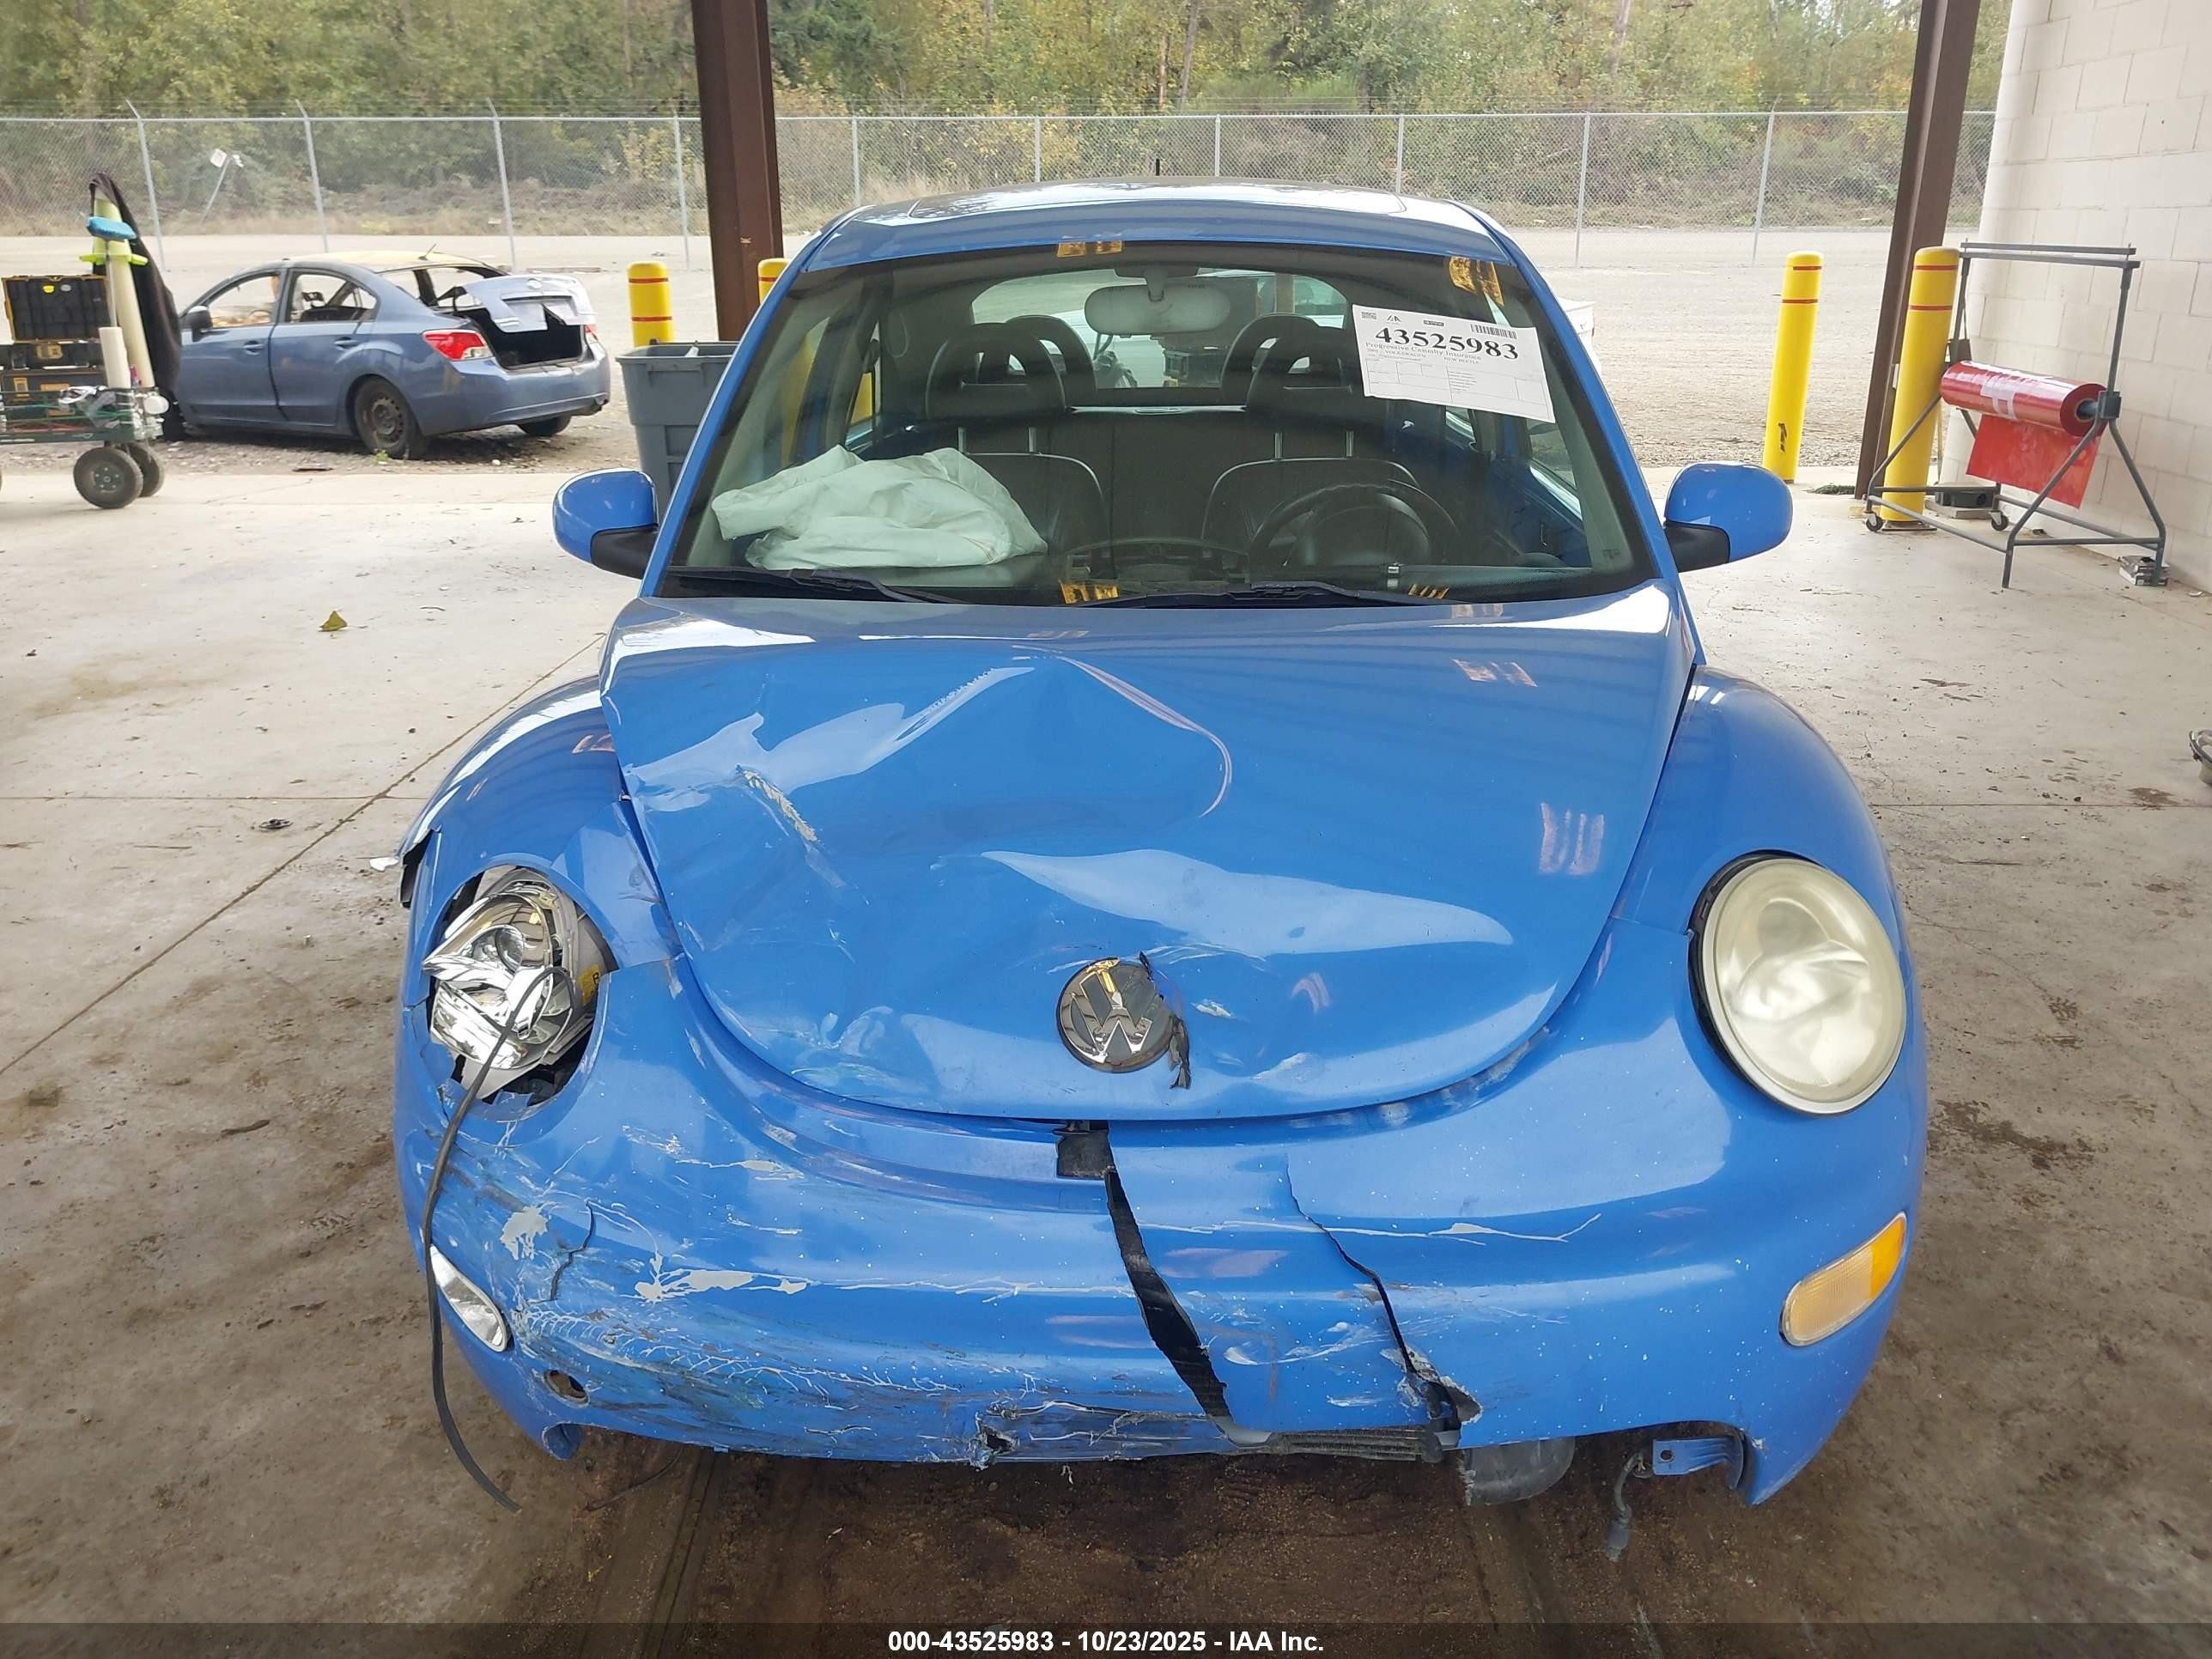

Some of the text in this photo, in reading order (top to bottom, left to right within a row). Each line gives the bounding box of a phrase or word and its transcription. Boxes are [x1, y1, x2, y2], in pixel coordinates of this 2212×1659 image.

[1365, 342, 1481, 360] Progressive Casualty Insurance
[1375, 327, 1518, 360] 43525983
